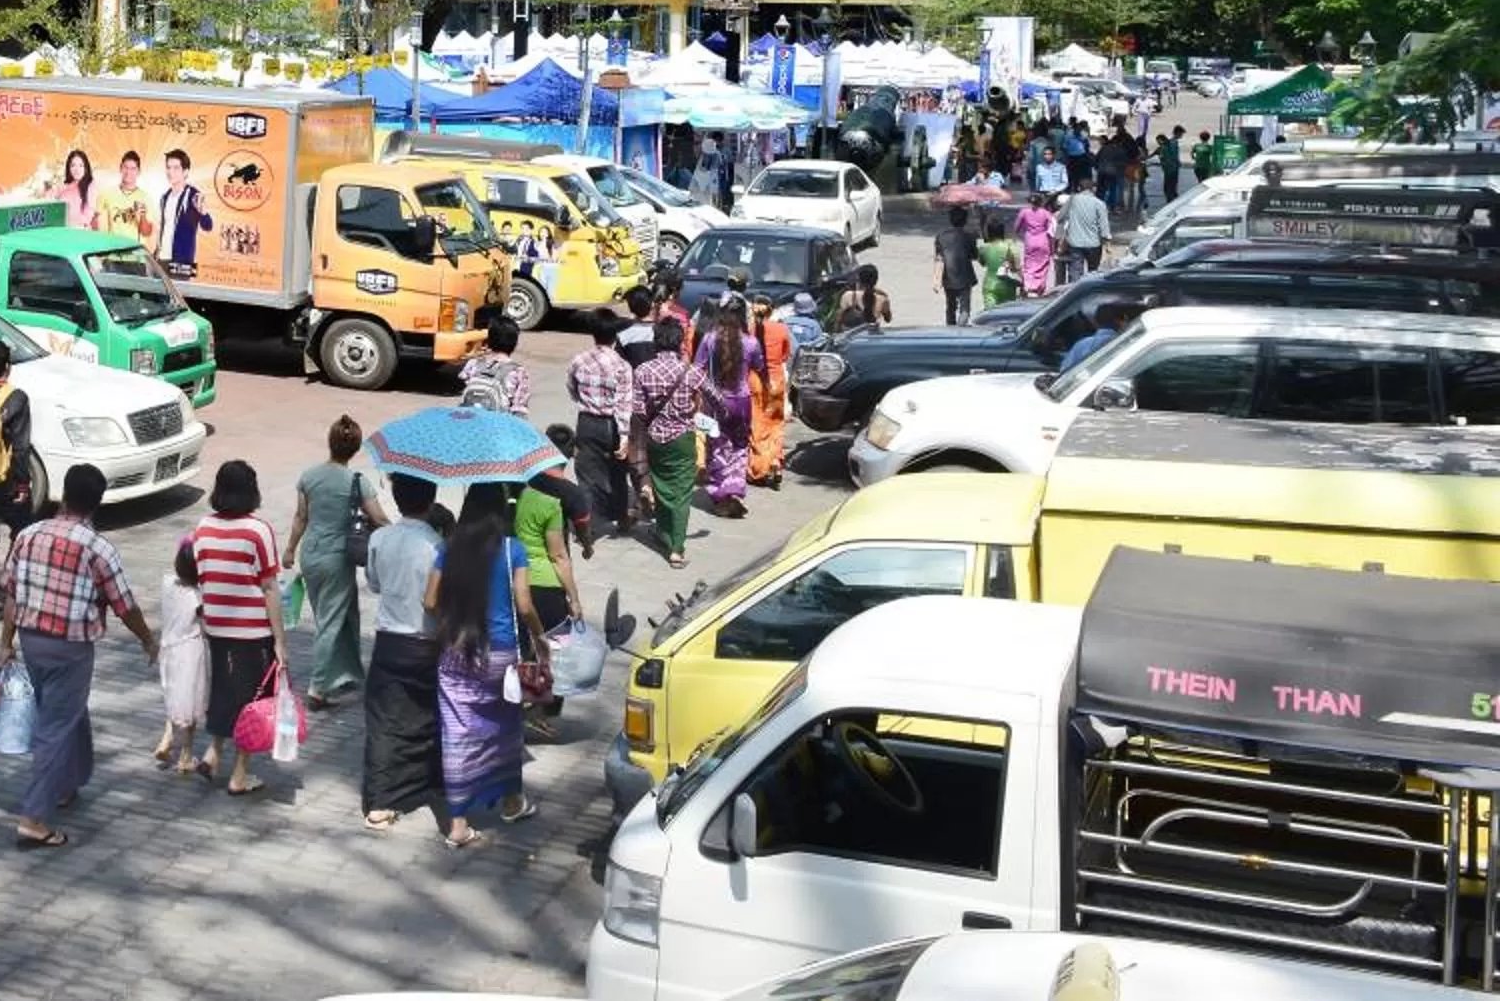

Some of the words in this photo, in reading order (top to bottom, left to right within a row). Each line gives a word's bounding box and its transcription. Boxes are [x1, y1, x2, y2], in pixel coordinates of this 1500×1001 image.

[1272, 220, 1342, 236] SMILEY
[1146, 666, 1236, 703] THEIN
[1272, 685, 1362, 719] THAN
